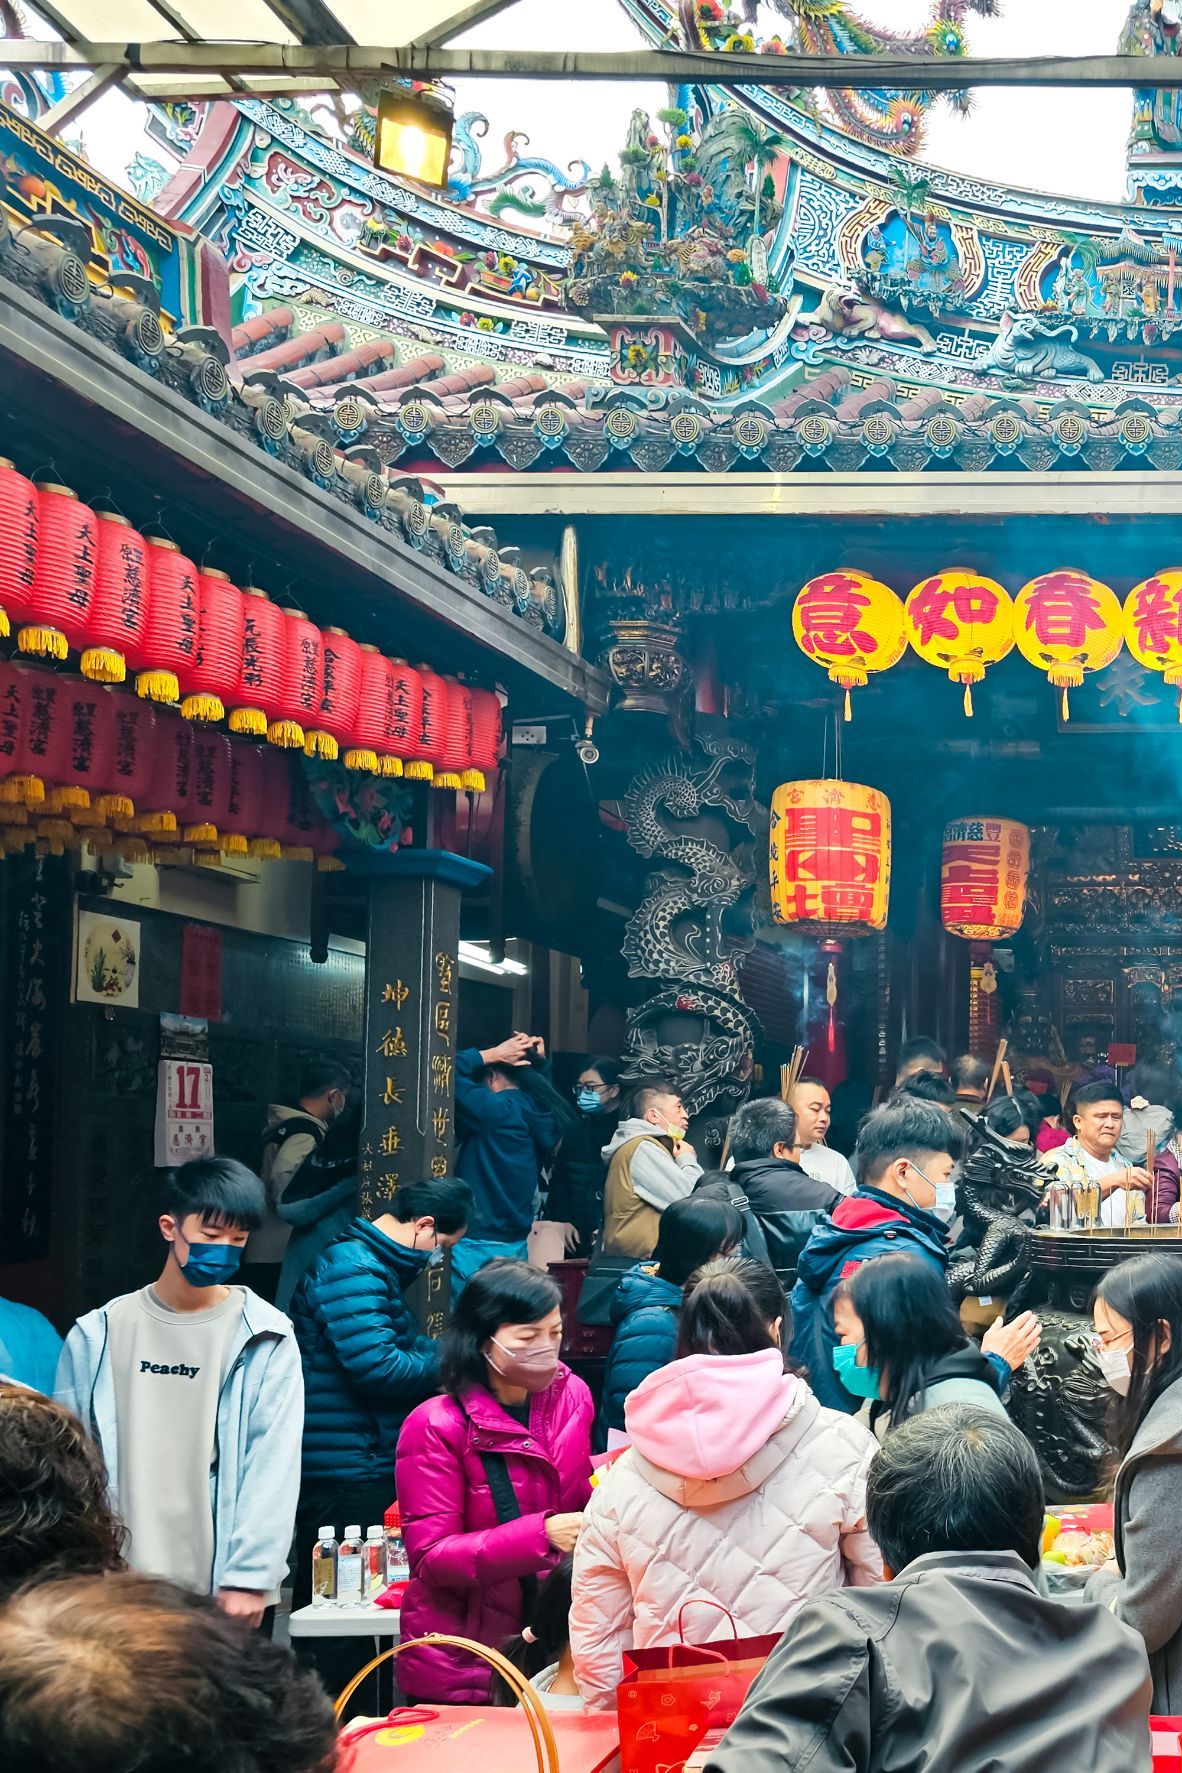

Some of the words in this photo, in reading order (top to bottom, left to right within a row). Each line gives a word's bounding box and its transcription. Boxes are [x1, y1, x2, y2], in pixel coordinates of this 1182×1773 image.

[66, 525, 96, 608] 天上聖母
[175, 1065, 202, 1109] 17
[140, 1360, 200, 1379] Peachy
